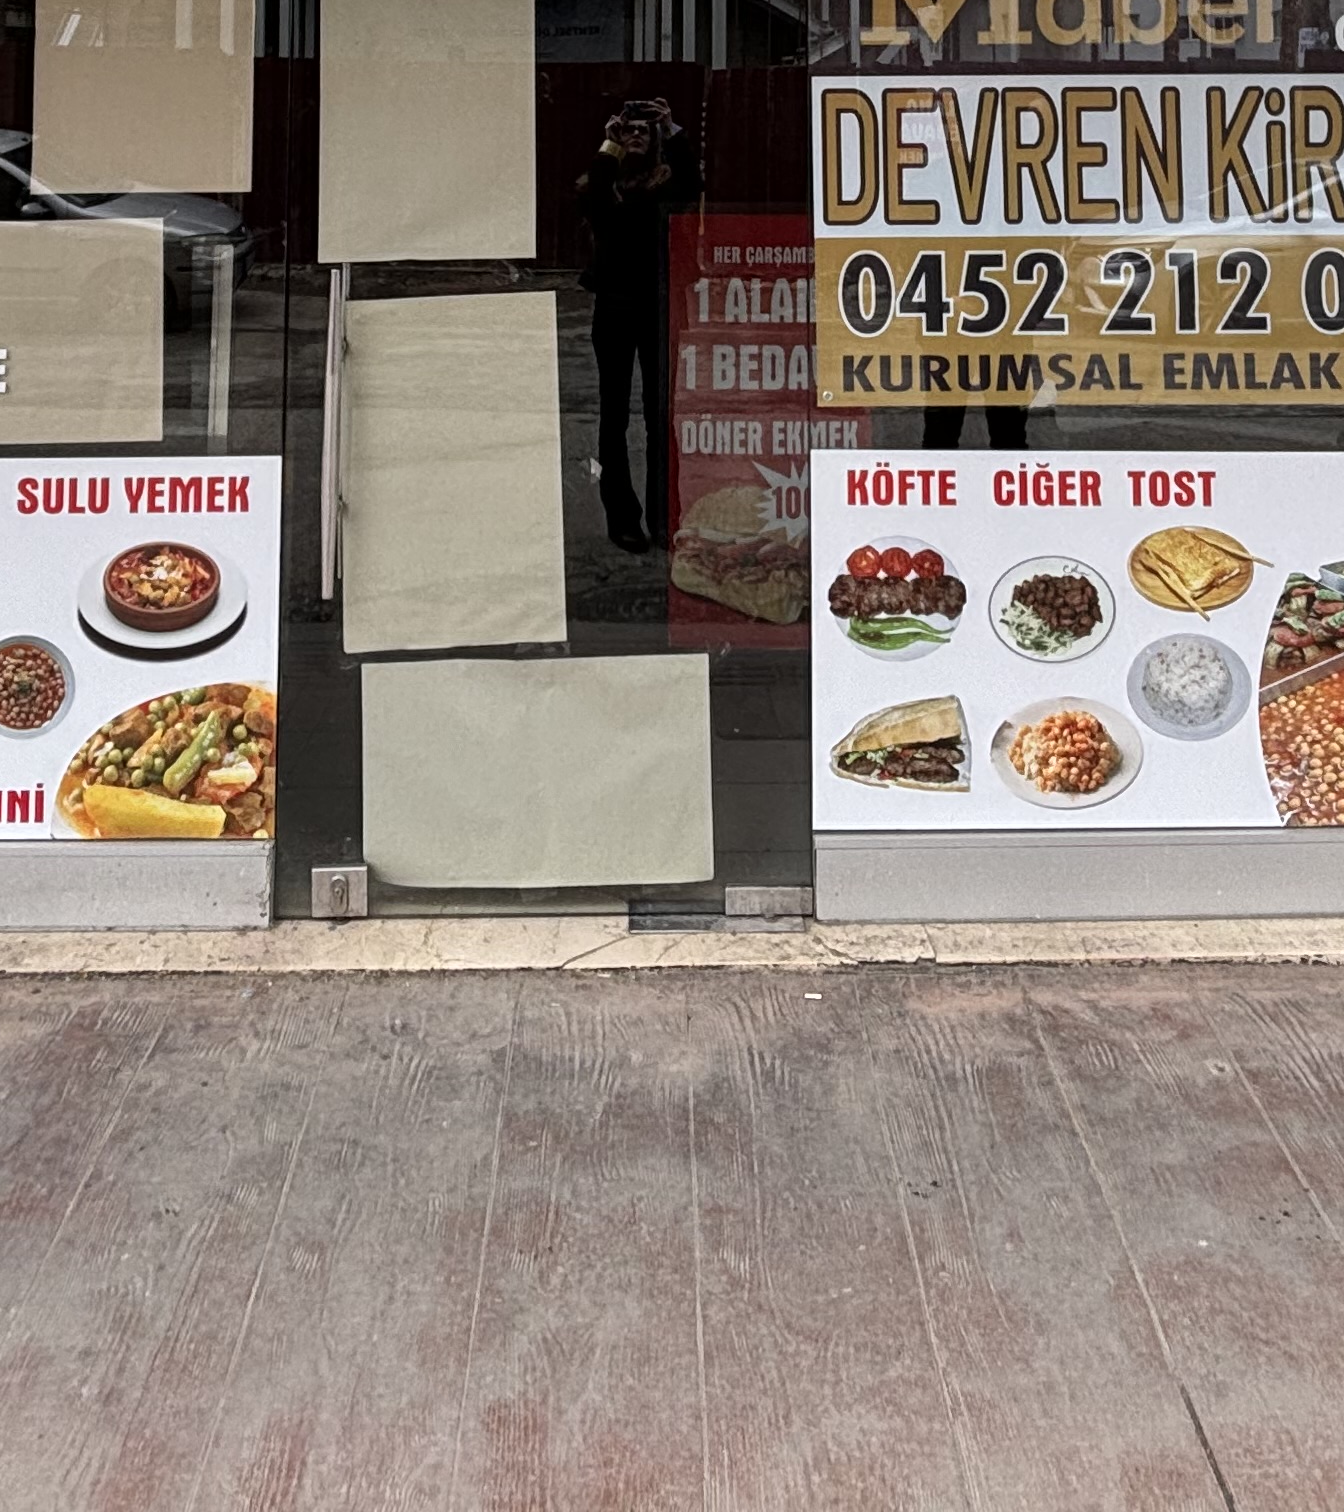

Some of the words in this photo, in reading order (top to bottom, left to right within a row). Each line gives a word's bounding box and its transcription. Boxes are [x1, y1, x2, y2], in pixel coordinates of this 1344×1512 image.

[820, 84, 1185, 226] DEVREN
[713, 246, 741, 264] HER
[693, 277, 710, 323] 1
[838, 247, 1070, 337] 0452
[1099, 247, 1273, 337] 212
[680, 344, 697, 390] 1
[840, 351, 1145, 393] KURUMSAL
[1163, 351, 1342, 392] EMLAK
[680, 413, 763, 455] DÖNER
[16, 477, 110, 515] SULU
[123, 475, 250, 515] YEMEK
[846, 462, 957, 506] KÖFTE
[992, 461, 1103, 508] CİĞER
[1128, 470, 1217, 507] TOST
